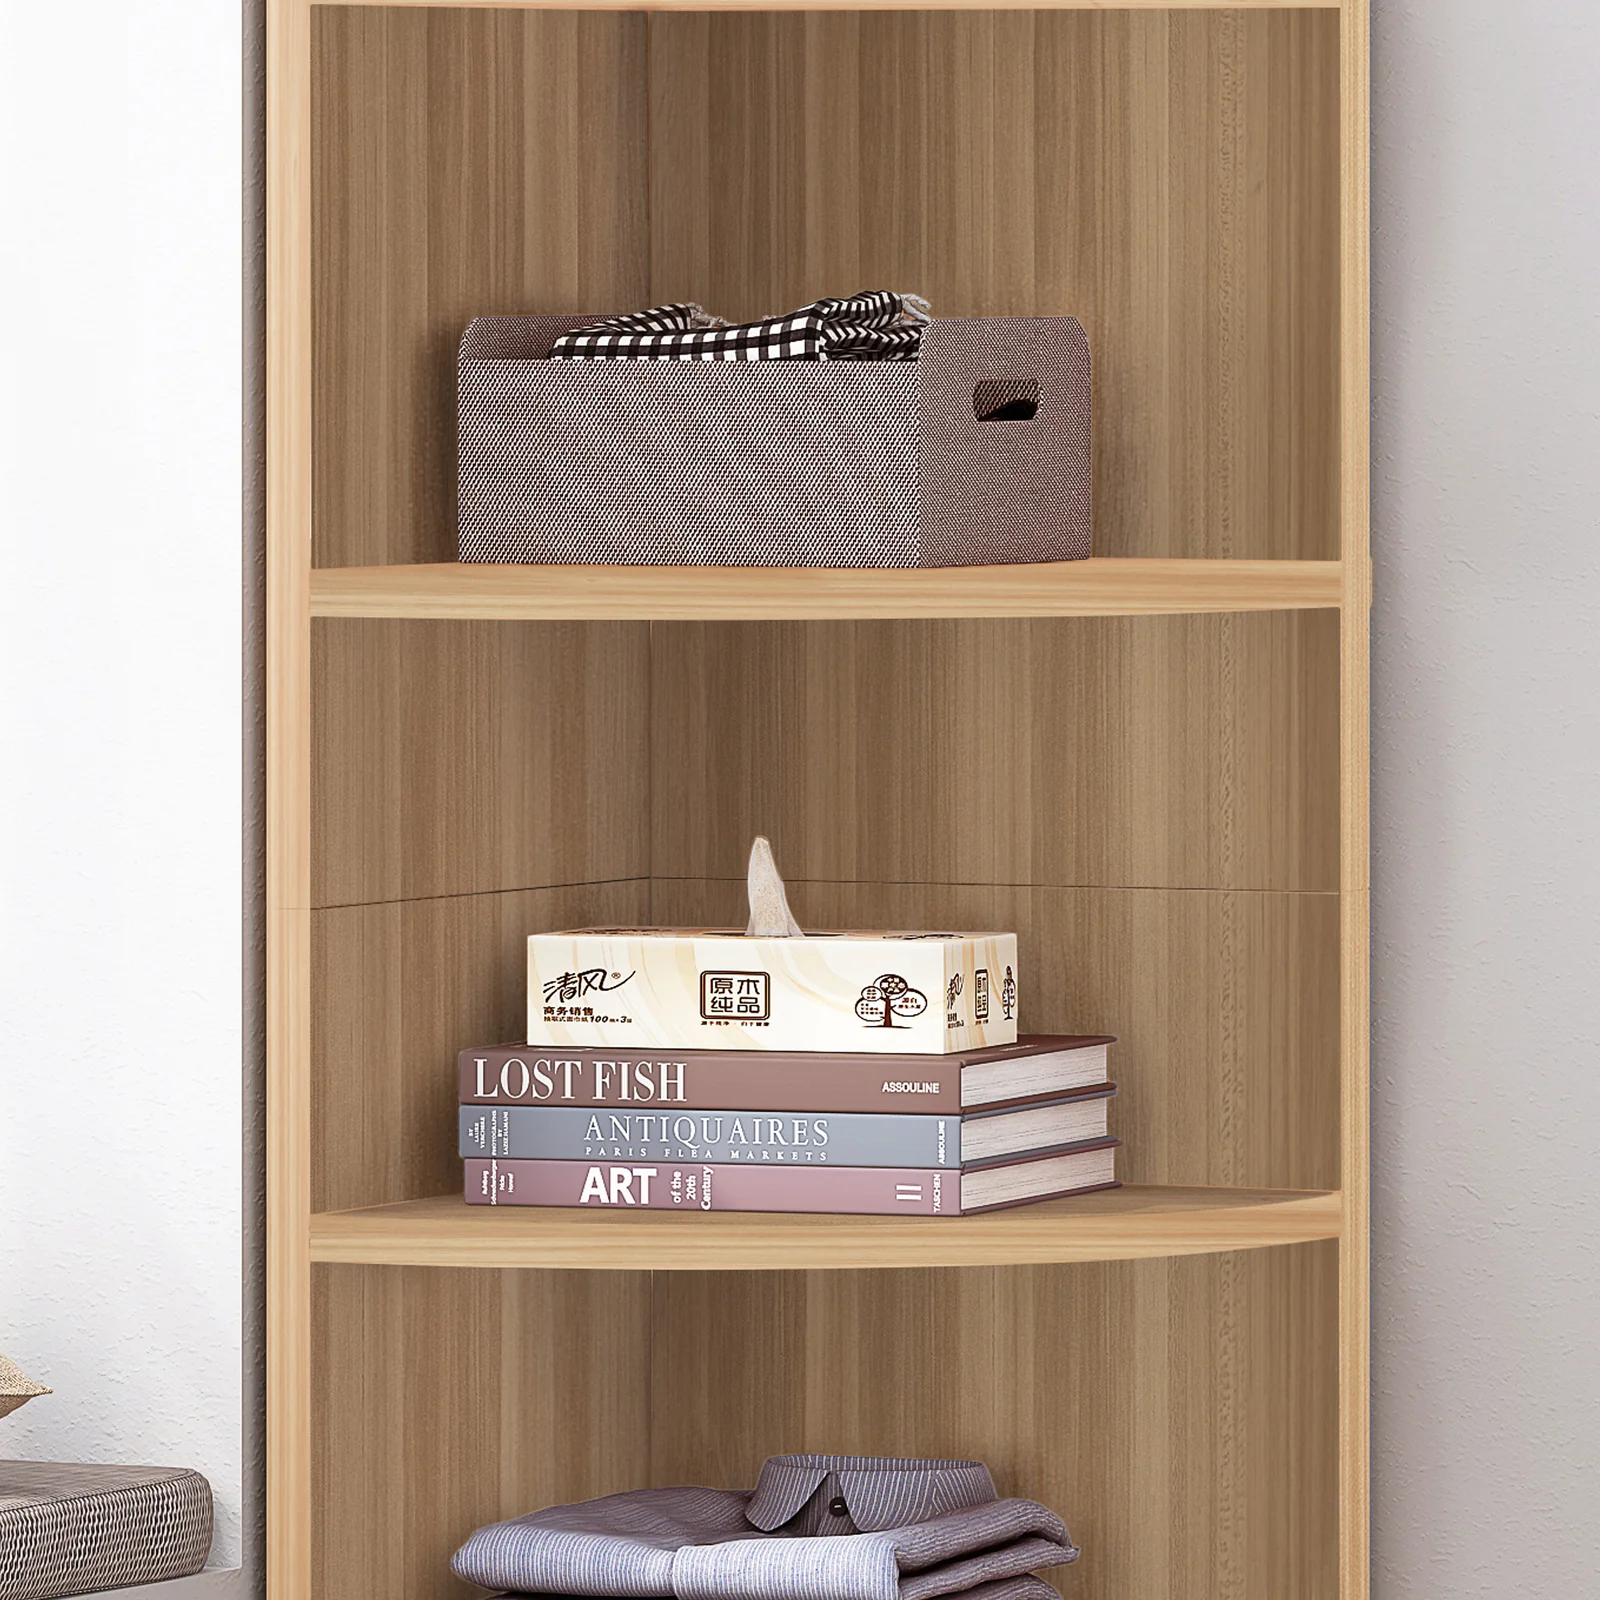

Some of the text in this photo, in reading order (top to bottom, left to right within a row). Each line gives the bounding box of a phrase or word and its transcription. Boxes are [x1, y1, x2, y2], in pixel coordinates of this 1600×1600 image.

[710, 977, 761, 995] 原木
[710, 996, 761, 1014] 纯品
[473, 1058, 687, 1102] LOST FISH
[882, 1081, 940, 1094] ASSOULINE
[584, 1114, 829, 1148] ANTIQUAIRES
[937, 1120, 946, 1164] ASSOULINE
[585, 1147, 828, 1161] PARIS FLEA MARKETS
[579, 1166, 658, 1205] ART
[672, 1171, 683, 1204] of the
[686, 1175, 697, 1200] 20th
[701, 1166, 714, 1210] Century
[933, 1173, 942, 1213] TASCHEN
